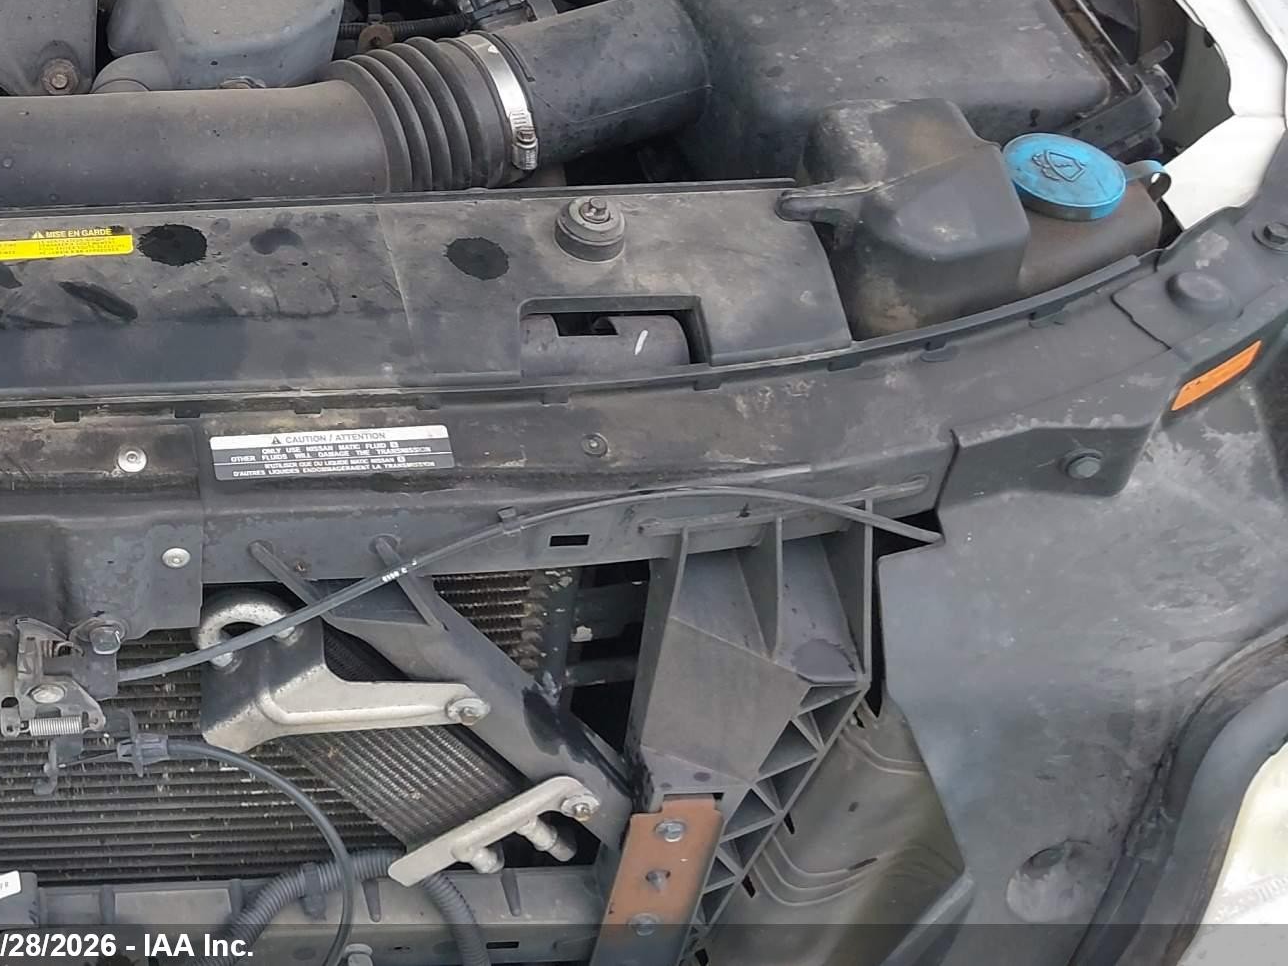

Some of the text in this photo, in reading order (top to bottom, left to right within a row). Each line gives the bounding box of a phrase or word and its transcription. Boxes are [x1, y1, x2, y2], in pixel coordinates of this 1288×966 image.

[81, 228, 113, 236] GARDE
[285, 435, 326, 444] CAUTION
[335, 432, 386, 441] ATTENTION
[261, 453, 288, 461] FLUIDS
[376, 446, 431, 454] TRANSMISSION
